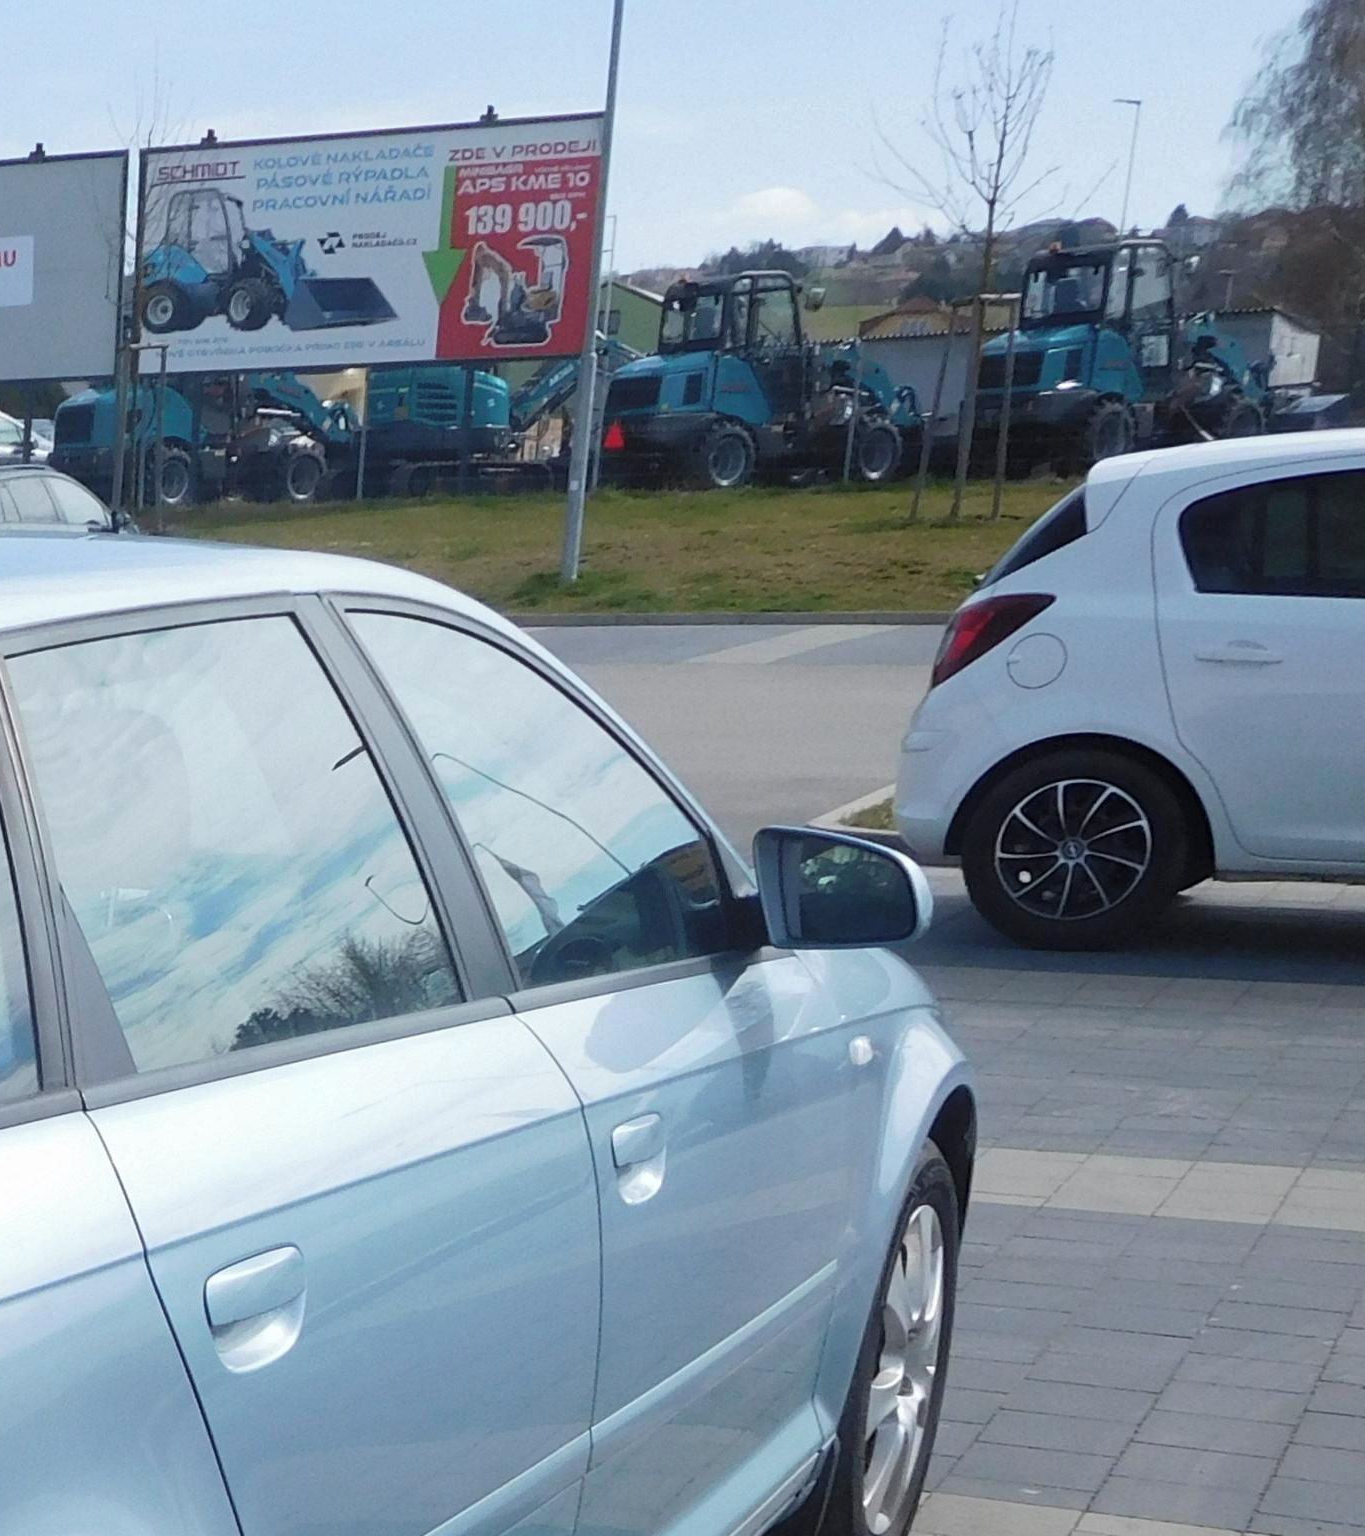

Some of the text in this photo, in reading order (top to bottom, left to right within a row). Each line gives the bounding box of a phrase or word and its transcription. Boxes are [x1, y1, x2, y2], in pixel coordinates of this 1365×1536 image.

[253, 143, 436, 171] KOLOVÉ NAKLADAČE
[449, 139, 597, 162] ZDE V PRODEJI
[158, 161, 240, 182] SCHMIDT
[256, 165, 430, 191] PÁSOVÉ RÝPADLA
[457, 171, 590, 195] APS KME 10
[252, 184, 432, 212] PRACOVNÍ NÁŘADÍ
[465, 200, 588, 235] 139 900,-
